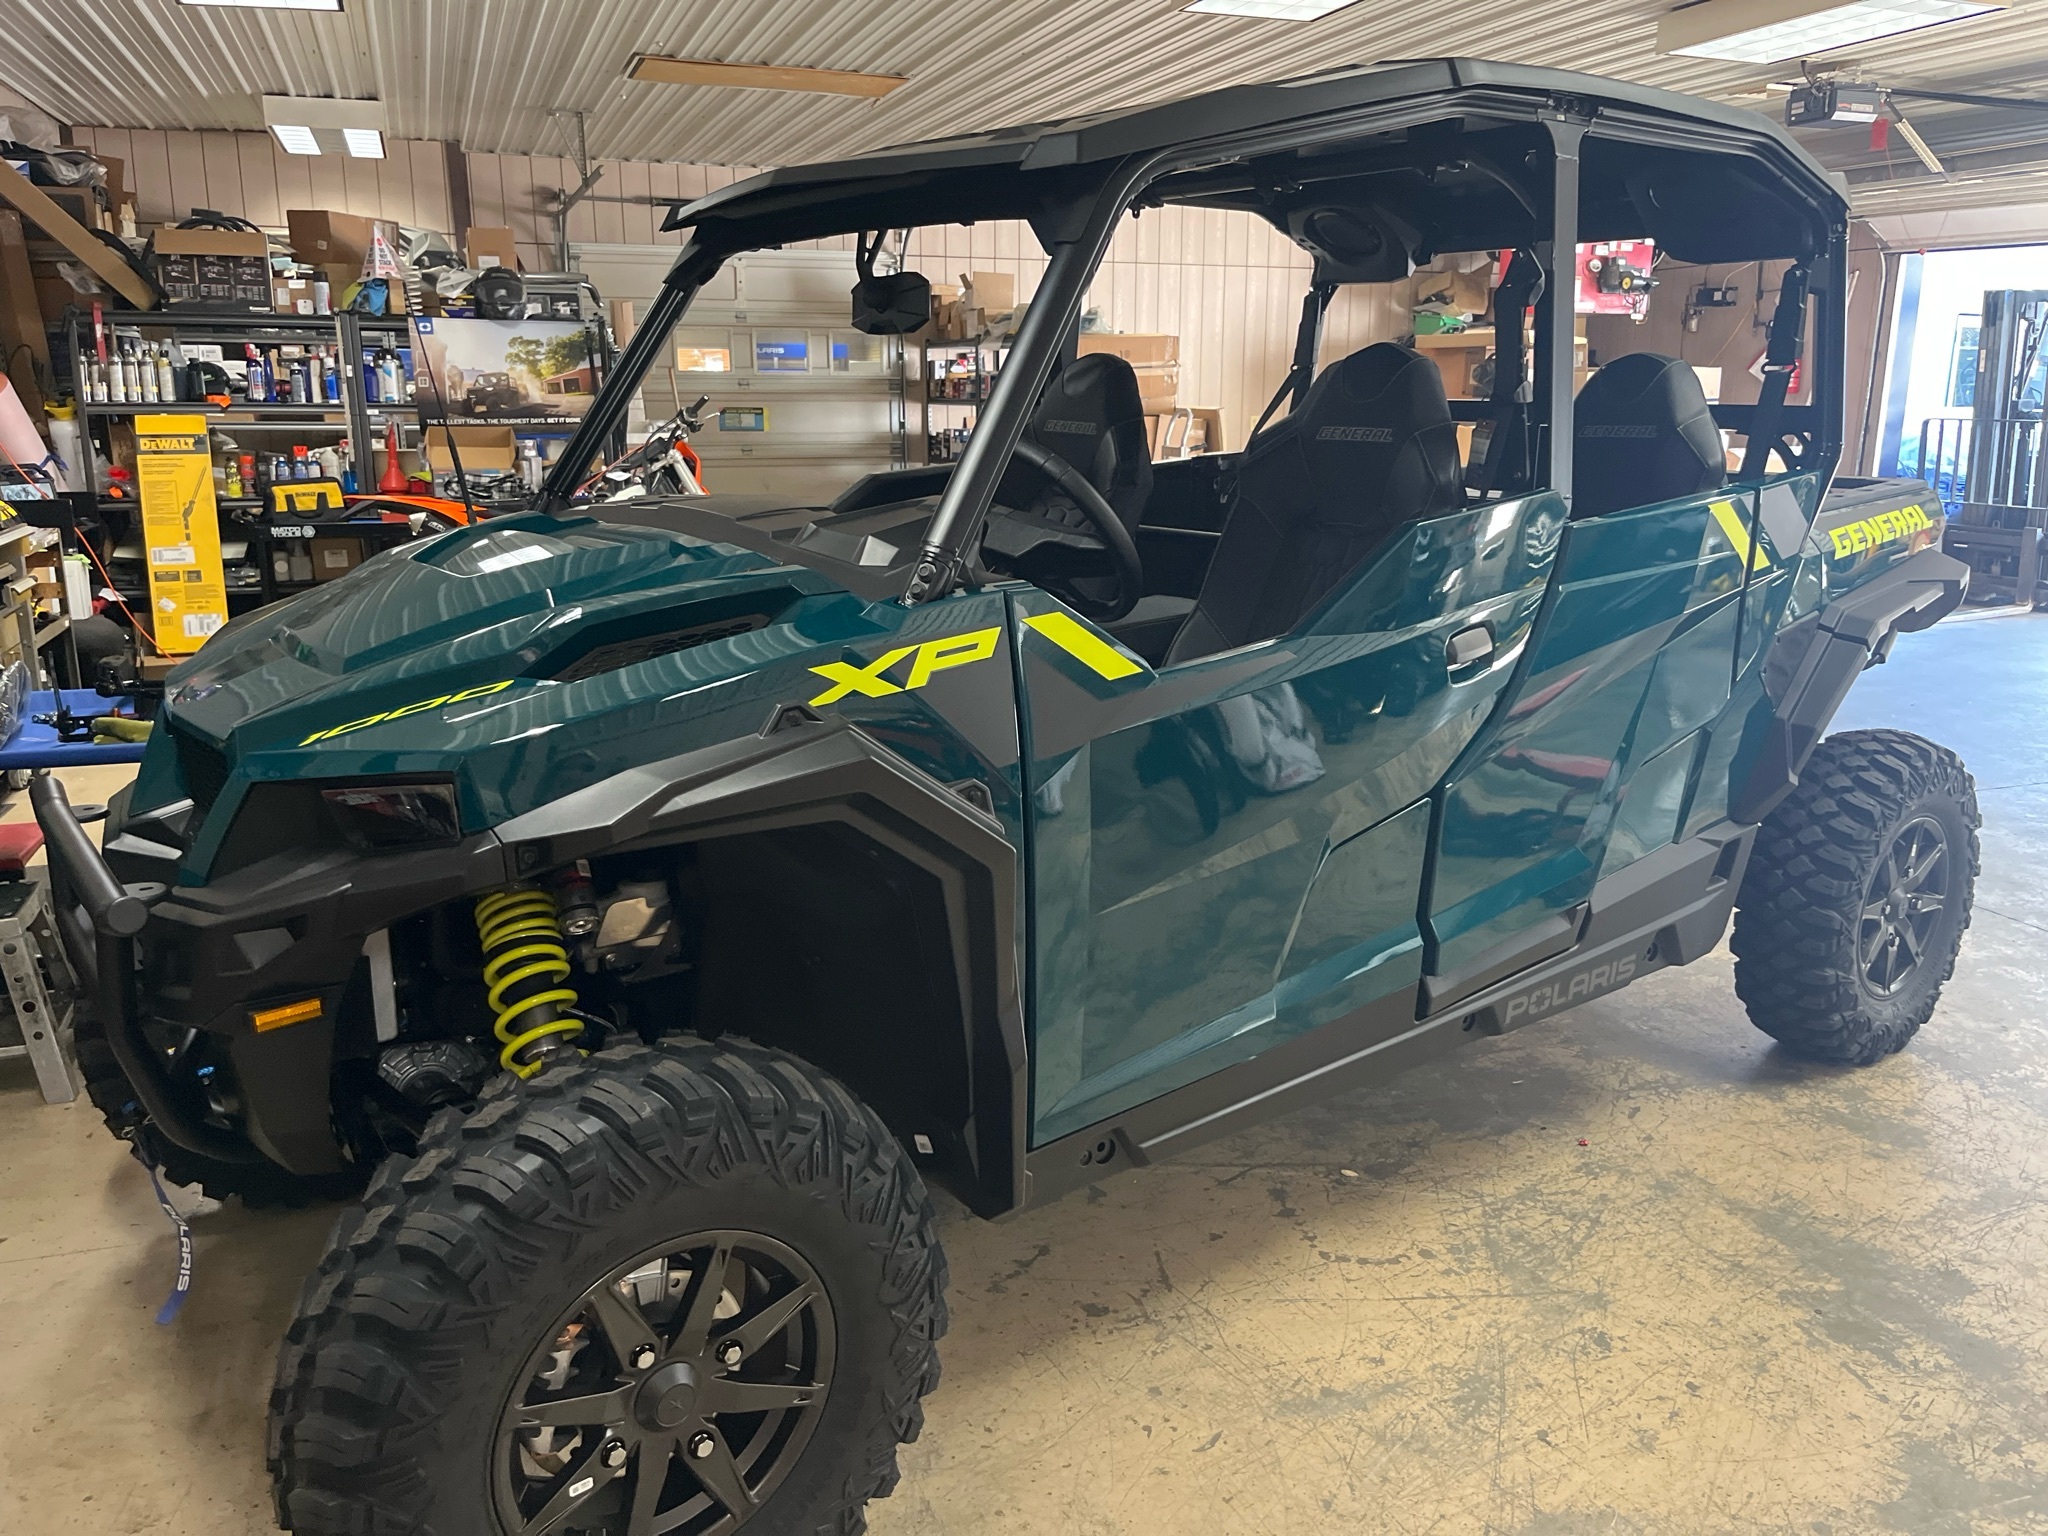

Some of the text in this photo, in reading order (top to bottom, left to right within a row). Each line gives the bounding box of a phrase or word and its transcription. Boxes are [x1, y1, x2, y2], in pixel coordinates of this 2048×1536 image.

[1043, 419, 1097, 435] GENERAL
[1316, 426, 1393, 442] GENERAL
[1578, 425, 1658, 438] GENERAL
[271, 526, 302, 534] MATCO
[1828, 504, 1934, 560] GENERAL
[807, 626, 1002, 708] XP
[298, 680, 515, 747] 1000
[1503, 954, 1638, 1025] POLARIS
[162, 1203, 192, 1292] POLARIS
